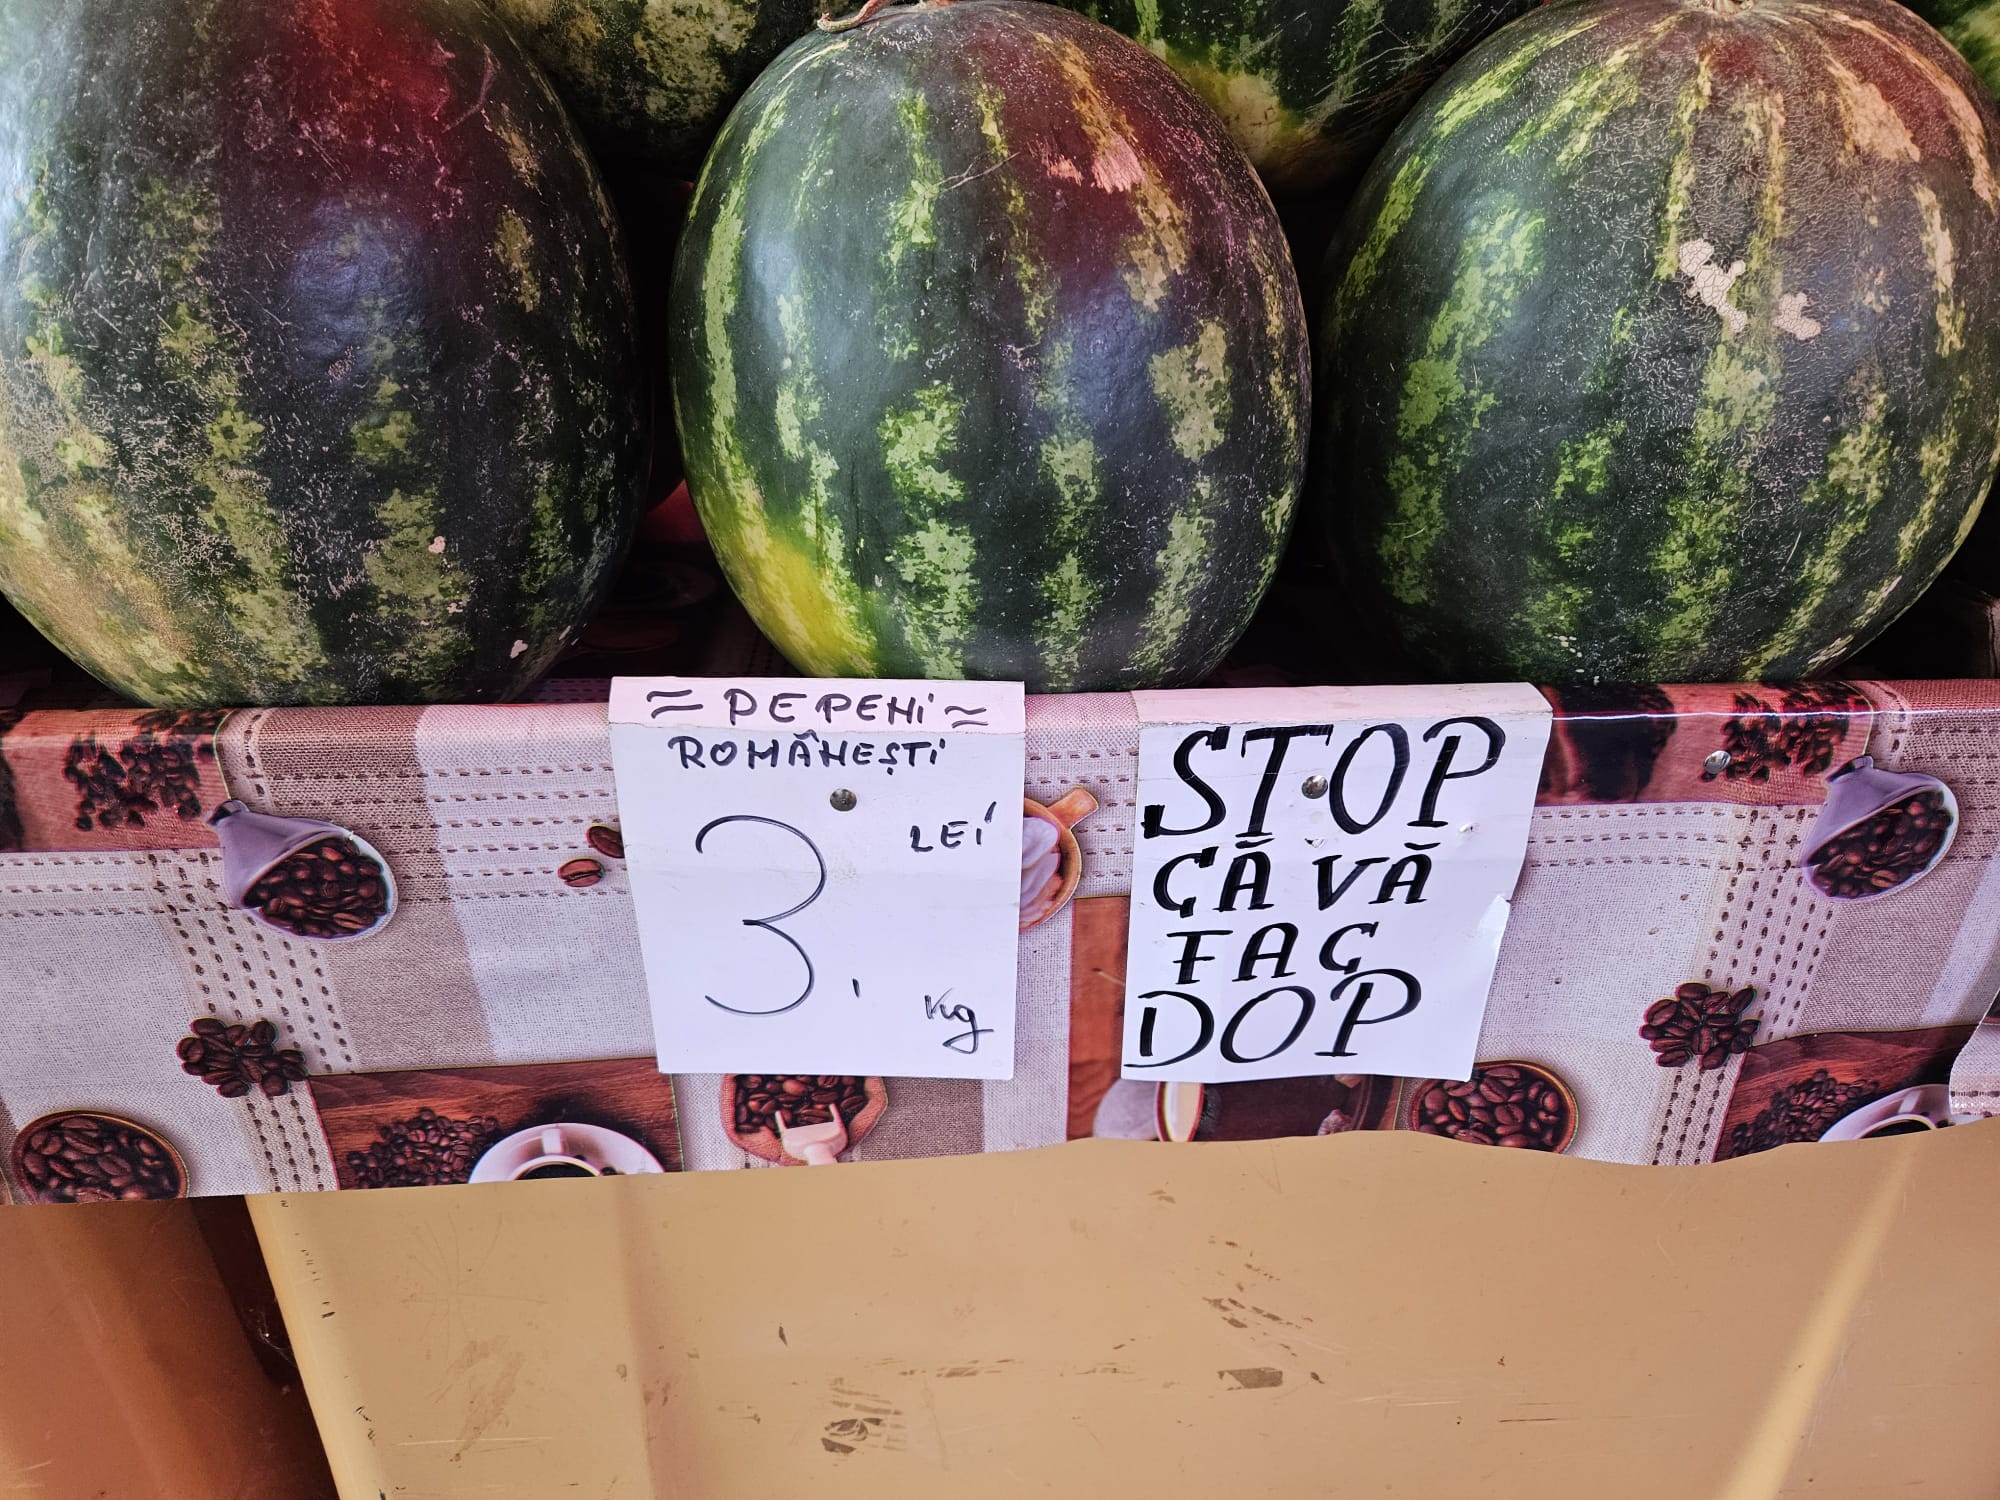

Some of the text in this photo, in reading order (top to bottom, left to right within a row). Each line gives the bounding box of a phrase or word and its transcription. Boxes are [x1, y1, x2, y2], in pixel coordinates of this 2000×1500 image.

[1141, 716, 1506, 839] STOP
[910, 801, 997, 852] LEI
[1313, 841, 1440, 911] VĂ
[1166, 921, 1379, 985] FAC
[1122, 968, 1422, 1068] DOP
